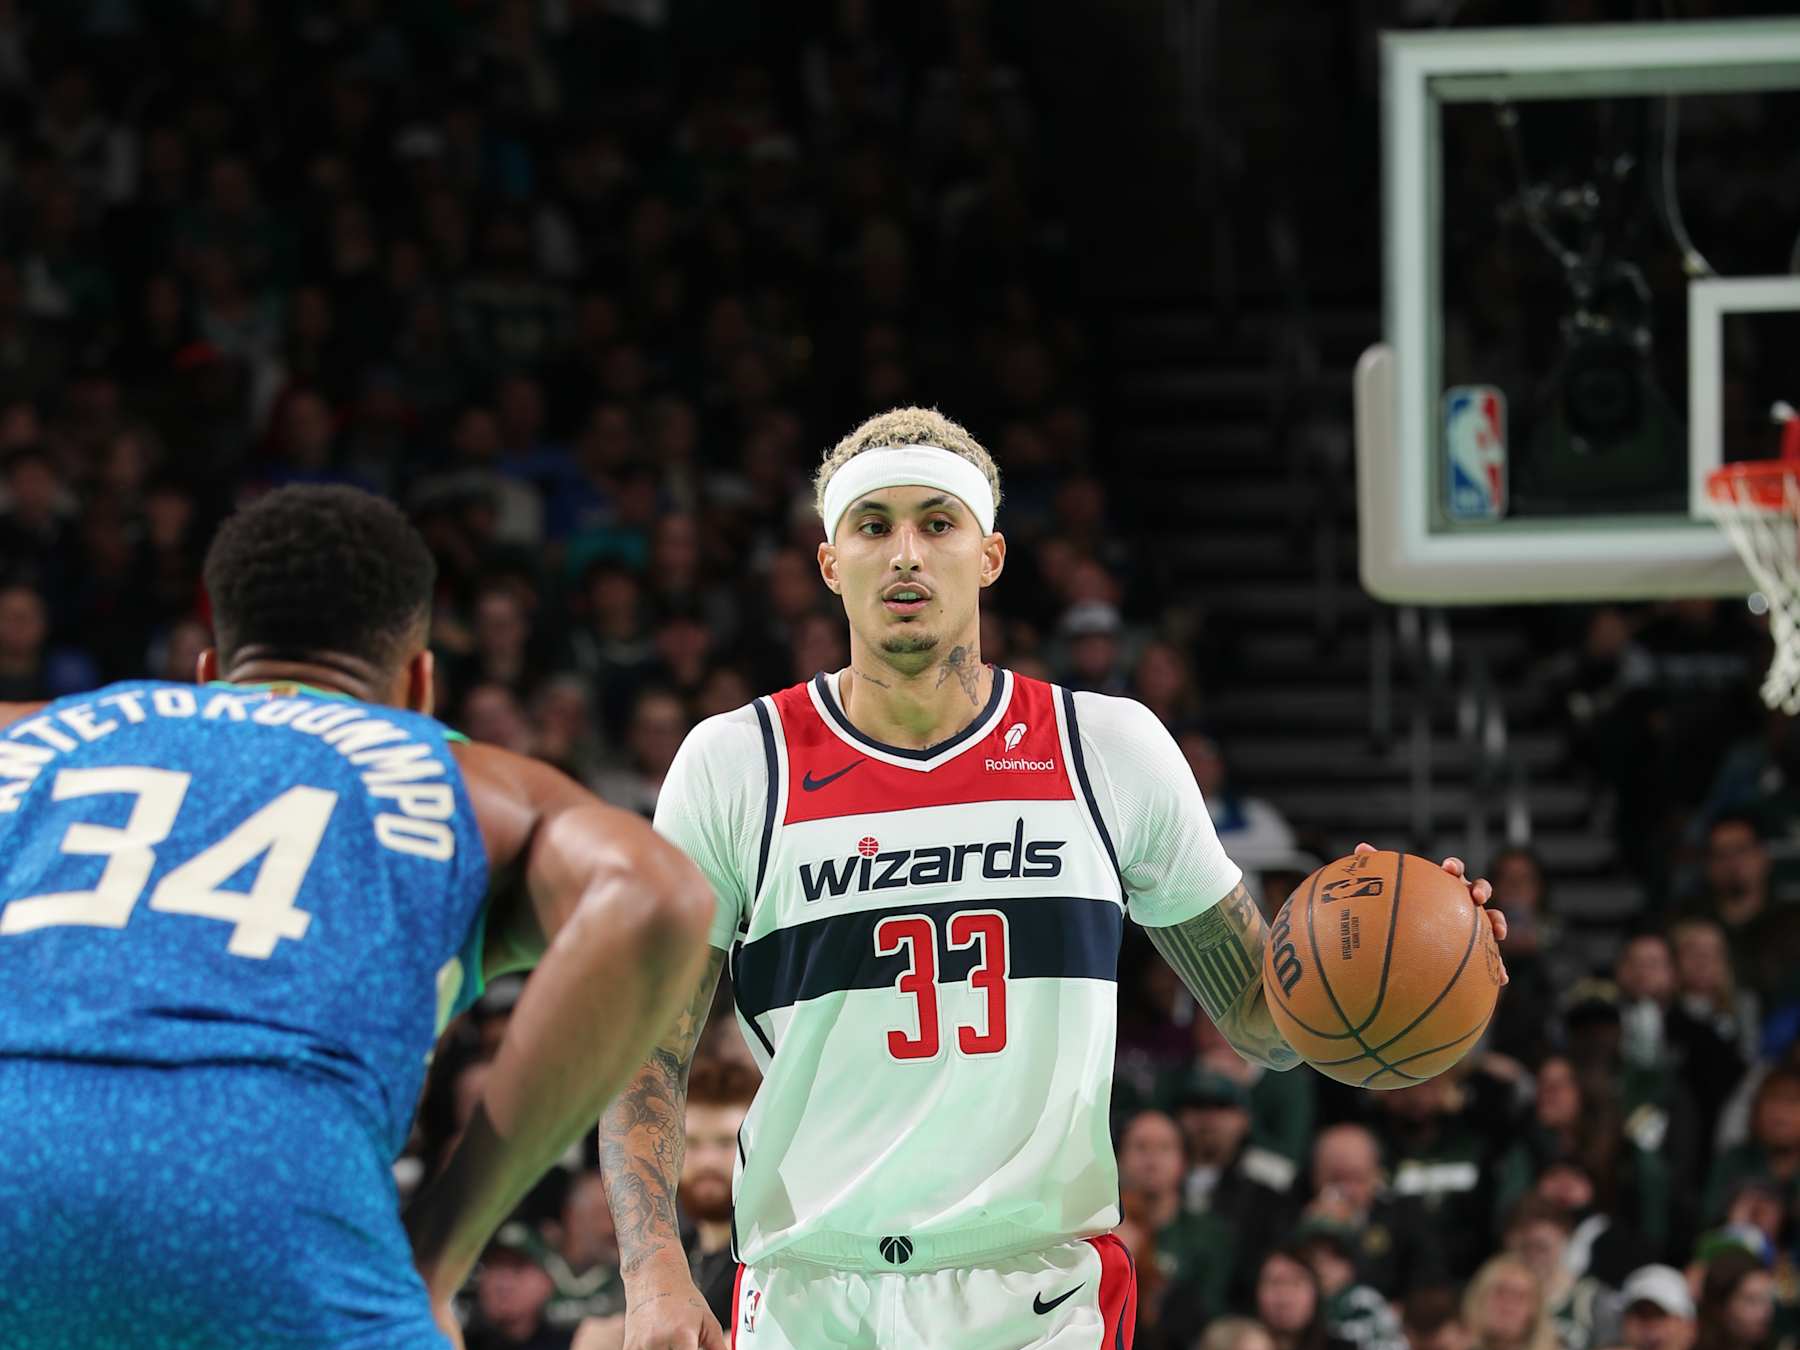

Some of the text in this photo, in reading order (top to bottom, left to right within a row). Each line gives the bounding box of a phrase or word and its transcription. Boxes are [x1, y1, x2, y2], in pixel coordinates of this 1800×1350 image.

[985, 758, 1055, 771] Robinhood
[0, 766, 338, 960] 34
[800, 817, 1067, 903] wizards
[875, 910, 1009, 1062] 33
